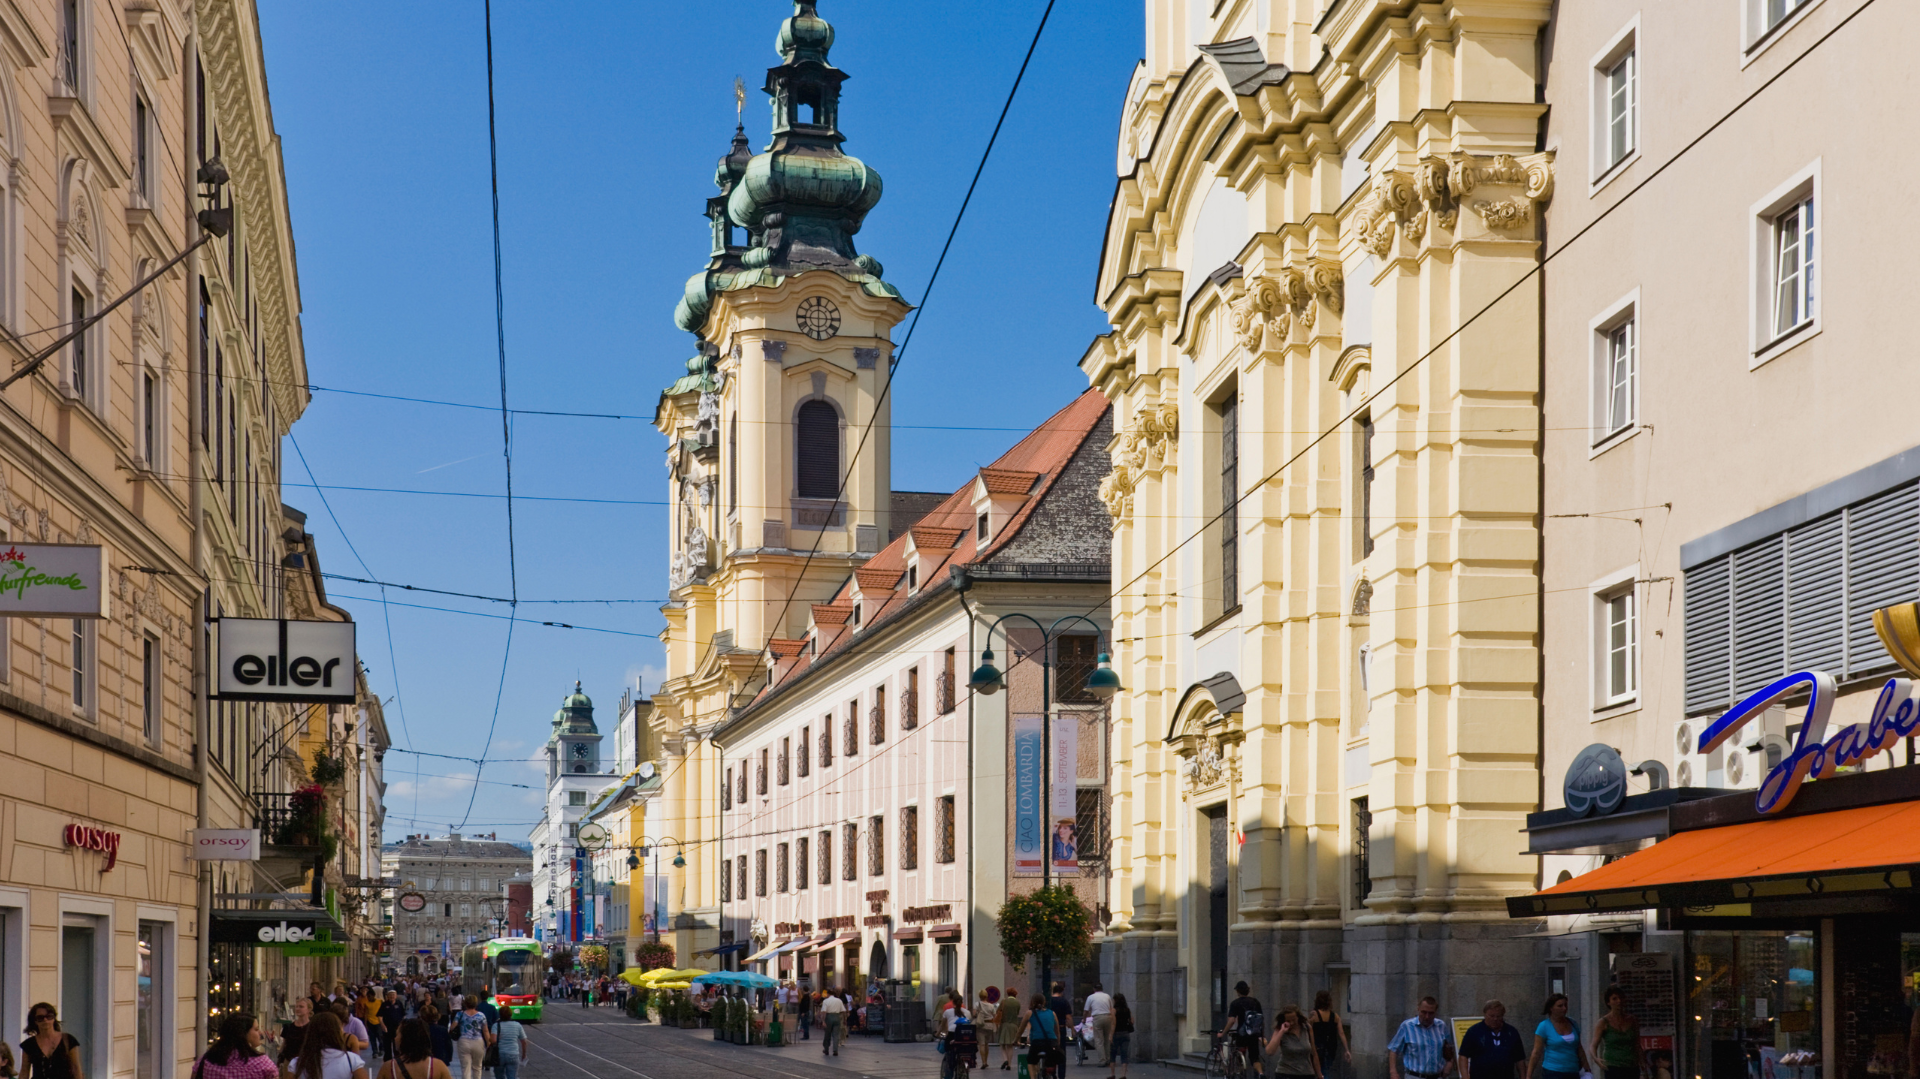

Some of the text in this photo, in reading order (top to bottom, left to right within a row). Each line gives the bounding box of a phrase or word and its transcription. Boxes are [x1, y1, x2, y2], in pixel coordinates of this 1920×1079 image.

[233, 636, 340, 687] eiler
[1020, 732, 1033, 814] LOMBARDIA
[1058, 739, 1068, 783] SEPTEMBER
[1579, 769, 1609, 790] pippig
[67, 822, 121, 873] orsay
[199, 838, 250, 850] orsay
[1020, 818, 1033, 853] CIAO
